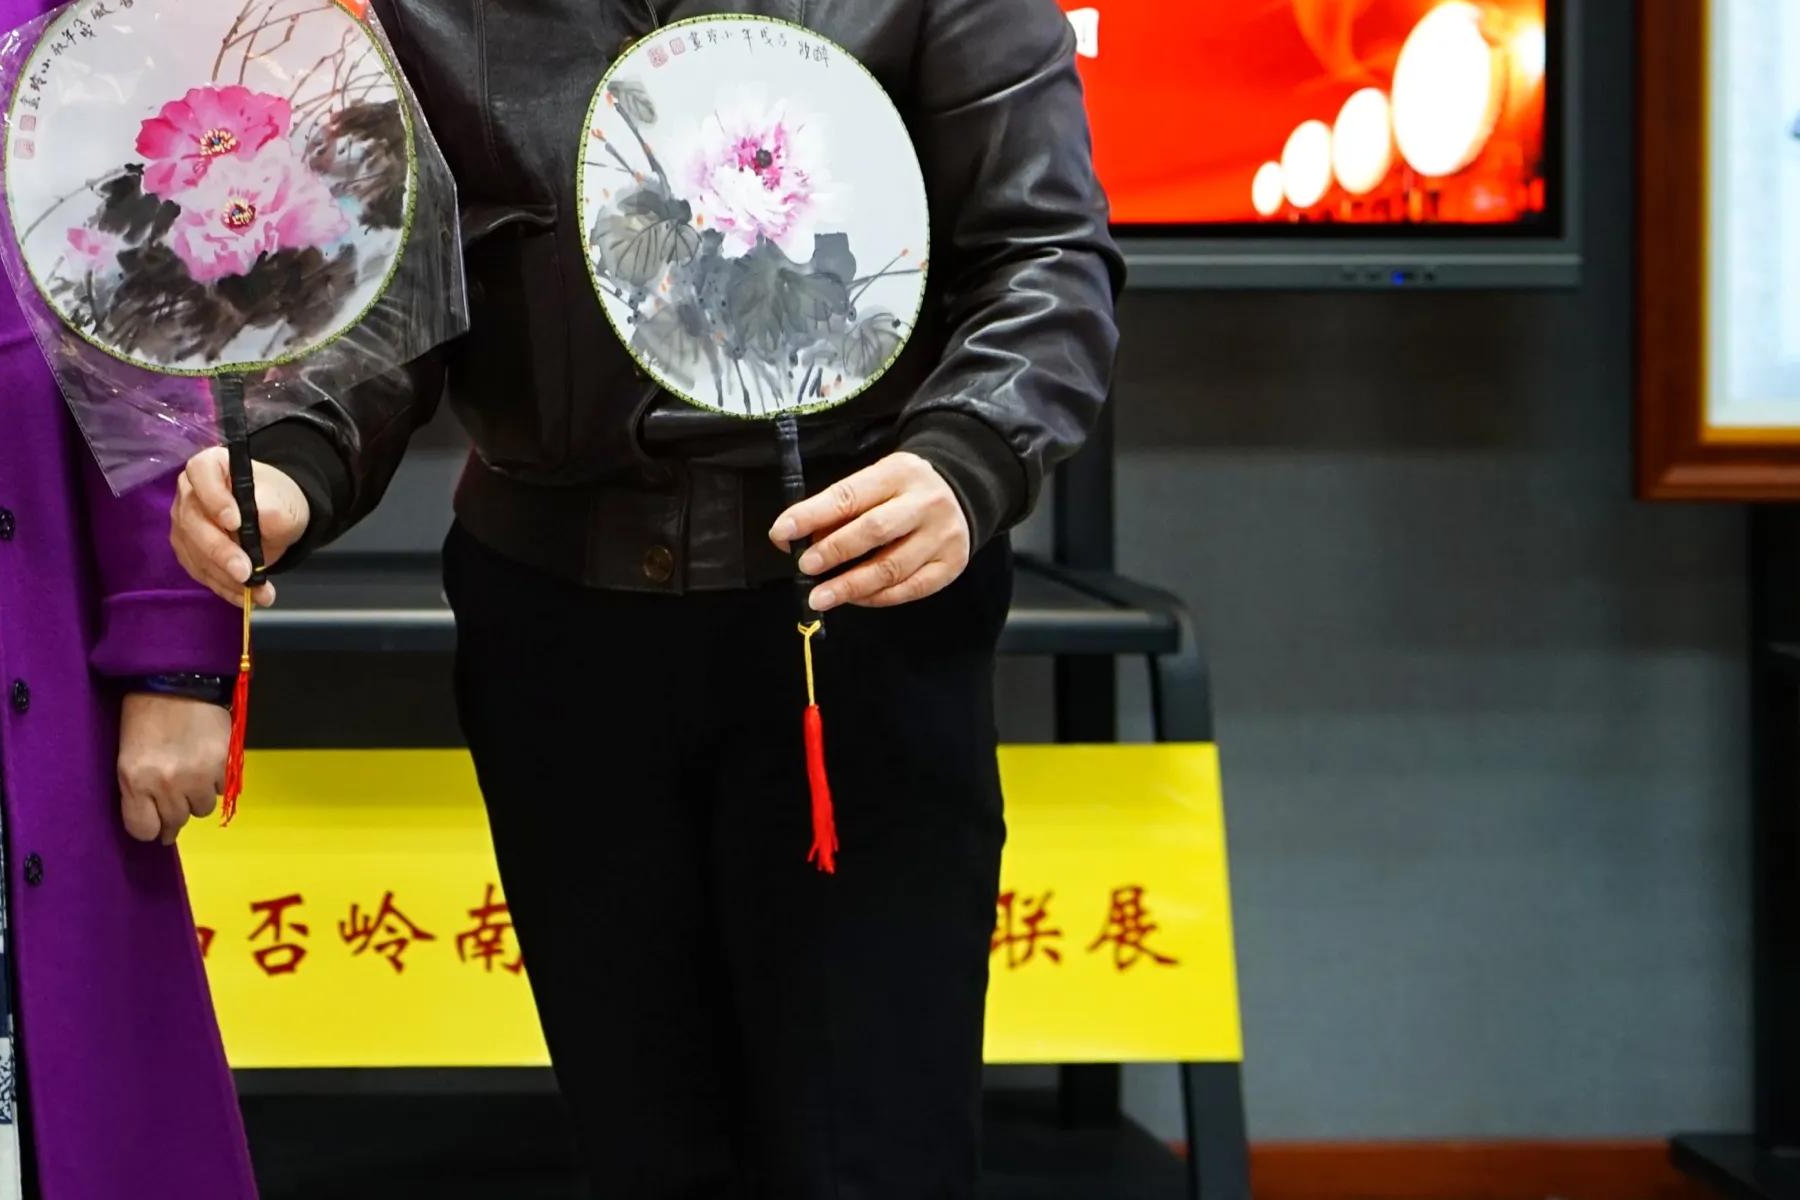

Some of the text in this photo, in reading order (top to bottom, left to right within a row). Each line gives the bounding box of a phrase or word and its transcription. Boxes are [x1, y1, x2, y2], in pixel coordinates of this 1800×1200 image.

[196, 883, 1179, 976] 否岭南 联展
